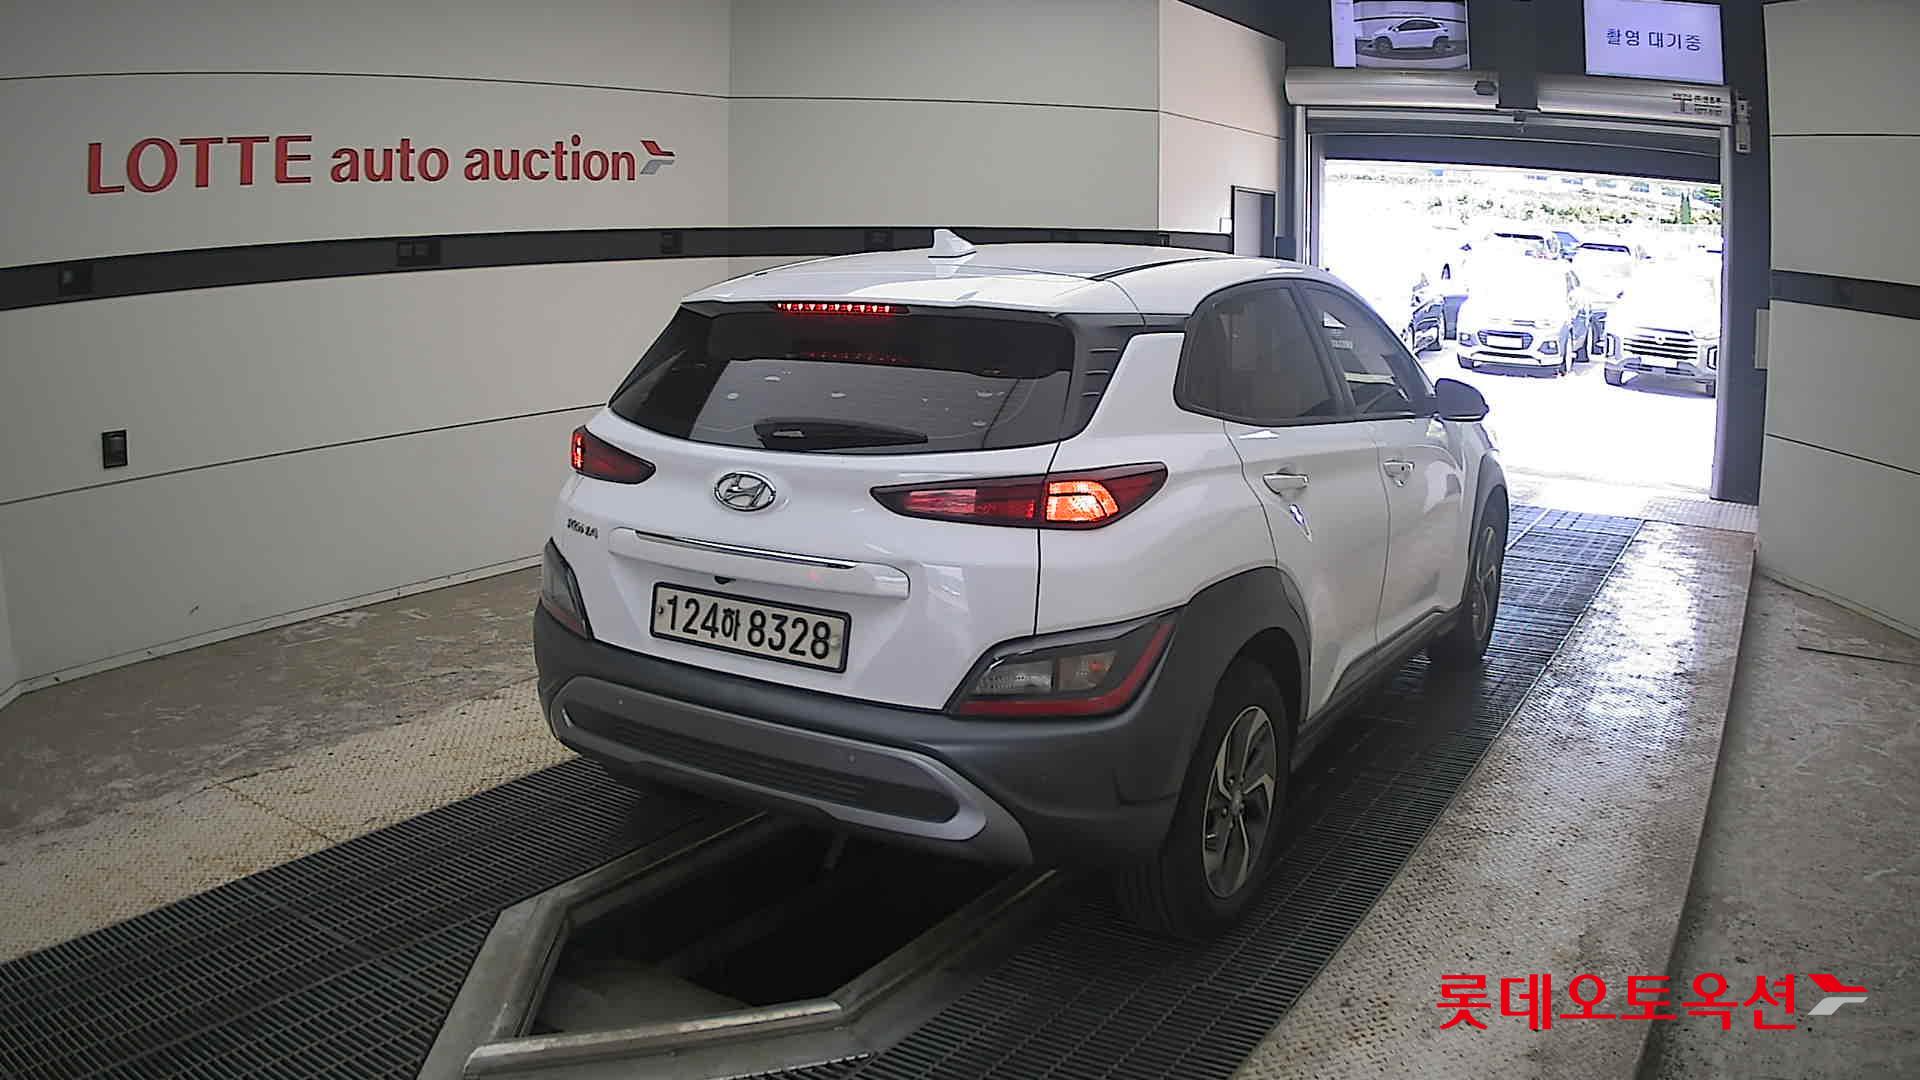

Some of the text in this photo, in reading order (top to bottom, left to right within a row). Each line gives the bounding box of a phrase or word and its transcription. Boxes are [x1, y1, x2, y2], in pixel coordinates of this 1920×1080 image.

[1648, 31, 1702, 52] 대기중
[87, 135, 637, 194] LOTTE auto auction
[667, 595, 832, 660] 124하 8328
